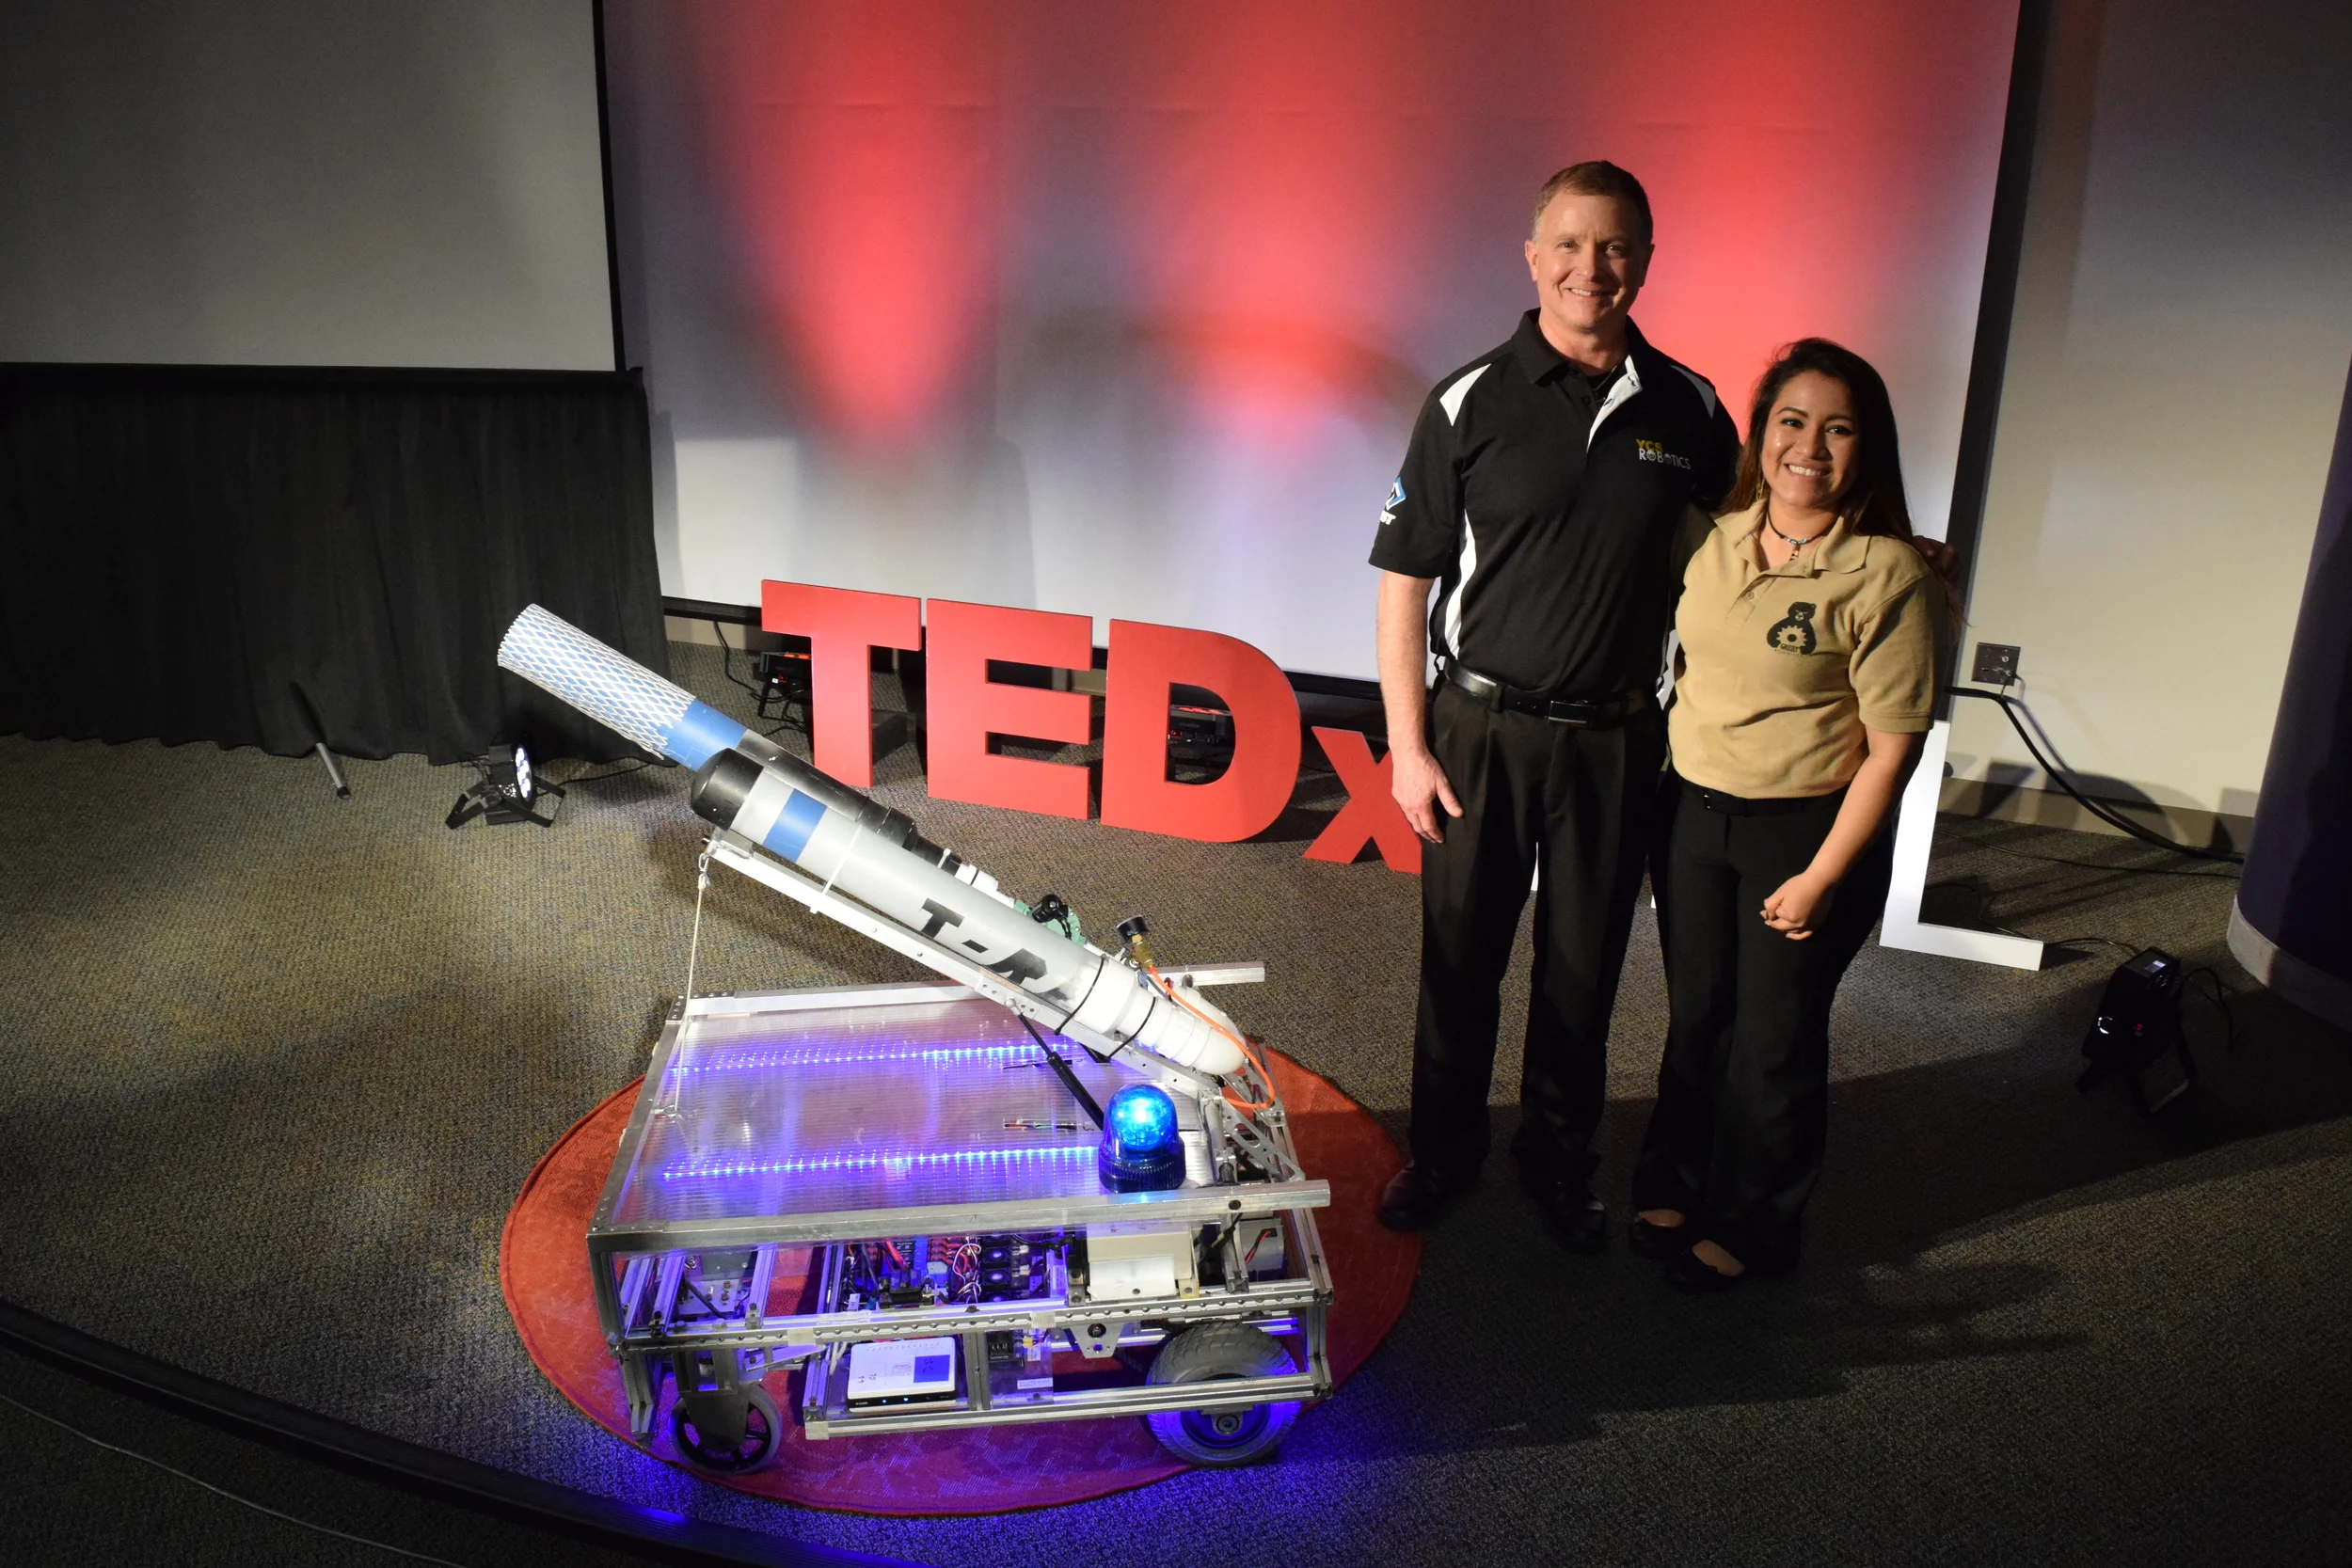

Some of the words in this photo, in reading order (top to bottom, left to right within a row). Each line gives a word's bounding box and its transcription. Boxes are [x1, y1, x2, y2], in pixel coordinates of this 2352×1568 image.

[1635, 438, 1662, 452] YCS
[1639, 448, 1691, 469] ROBOTICS
[761, 579, 1422, 875] TEDx
